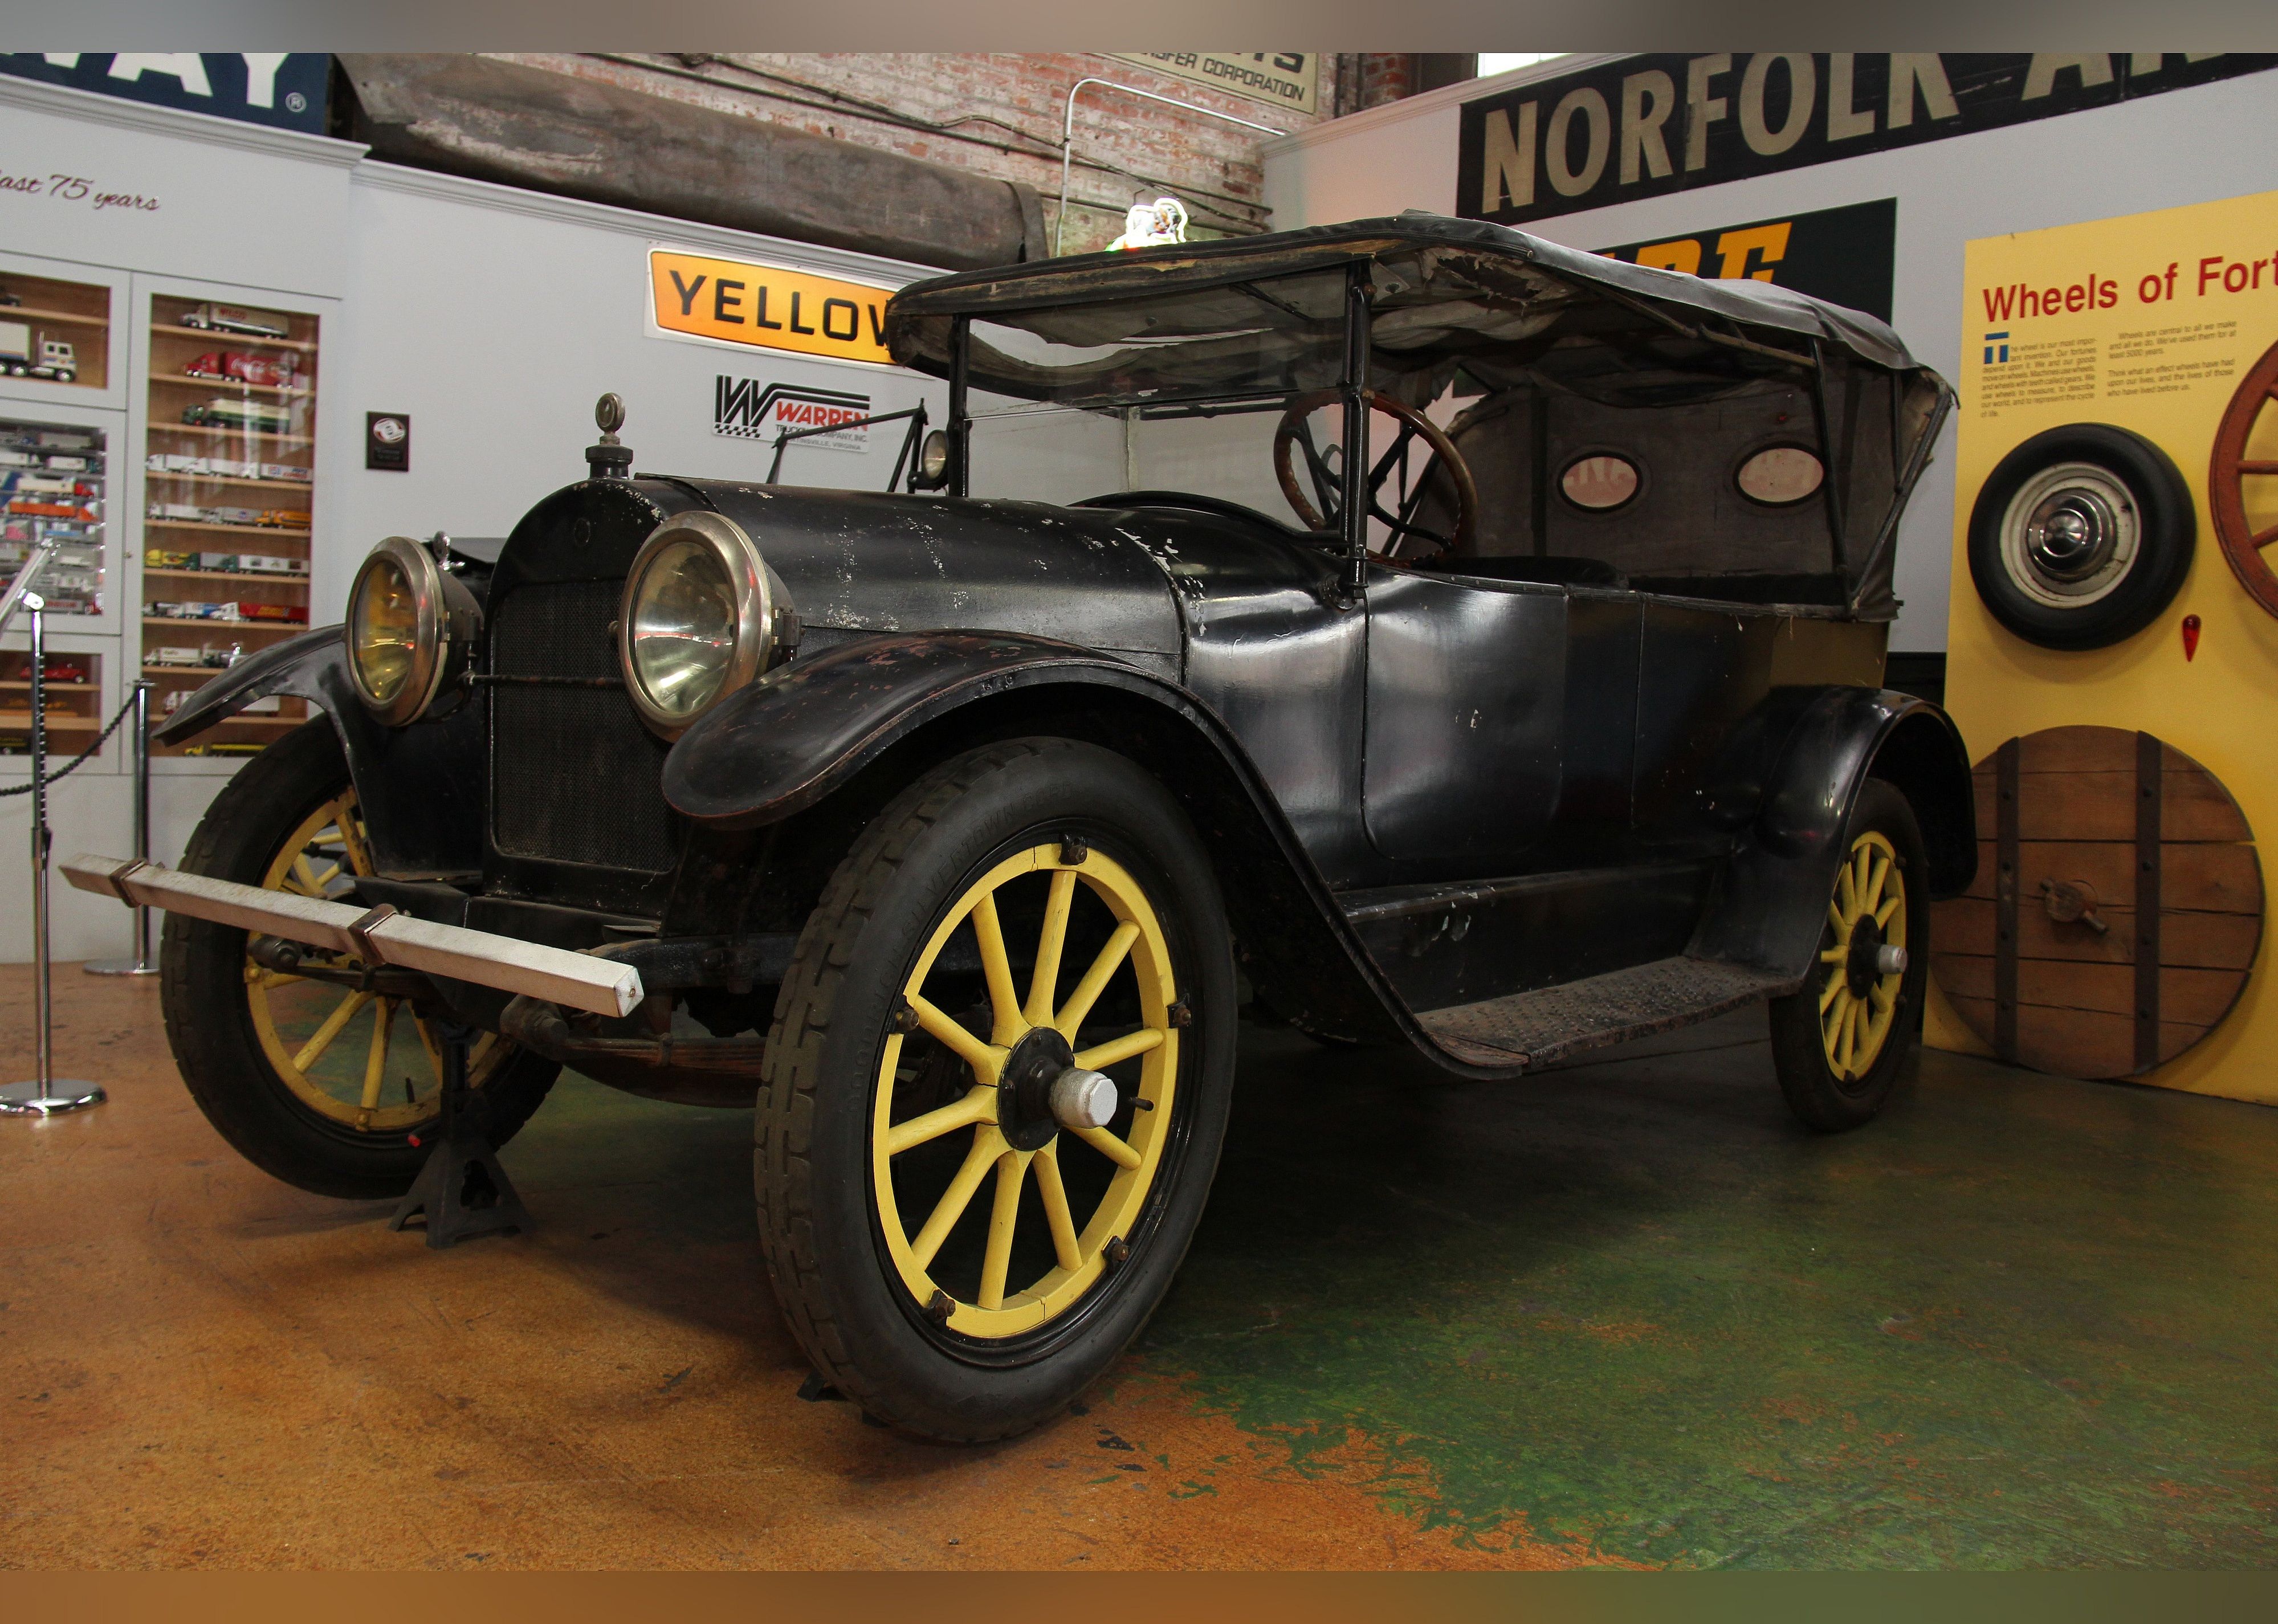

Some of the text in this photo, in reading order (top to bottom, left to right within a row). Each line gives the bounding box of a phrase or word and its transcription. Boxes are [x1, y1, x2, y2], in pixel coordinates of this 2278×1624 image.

[1203, 58, 1305, 101] CORPORATION
[1482, 53, 1959, 213] NORFOLK
[0, 173, 161, 211] ast 75 years
[1983, 274, 2118, 322] Wheels
[2138, 262, 2178, 303] of
[776, 401, 869, 431] WARREN
[902, 802, 1014, 935] SILVERTOWN
